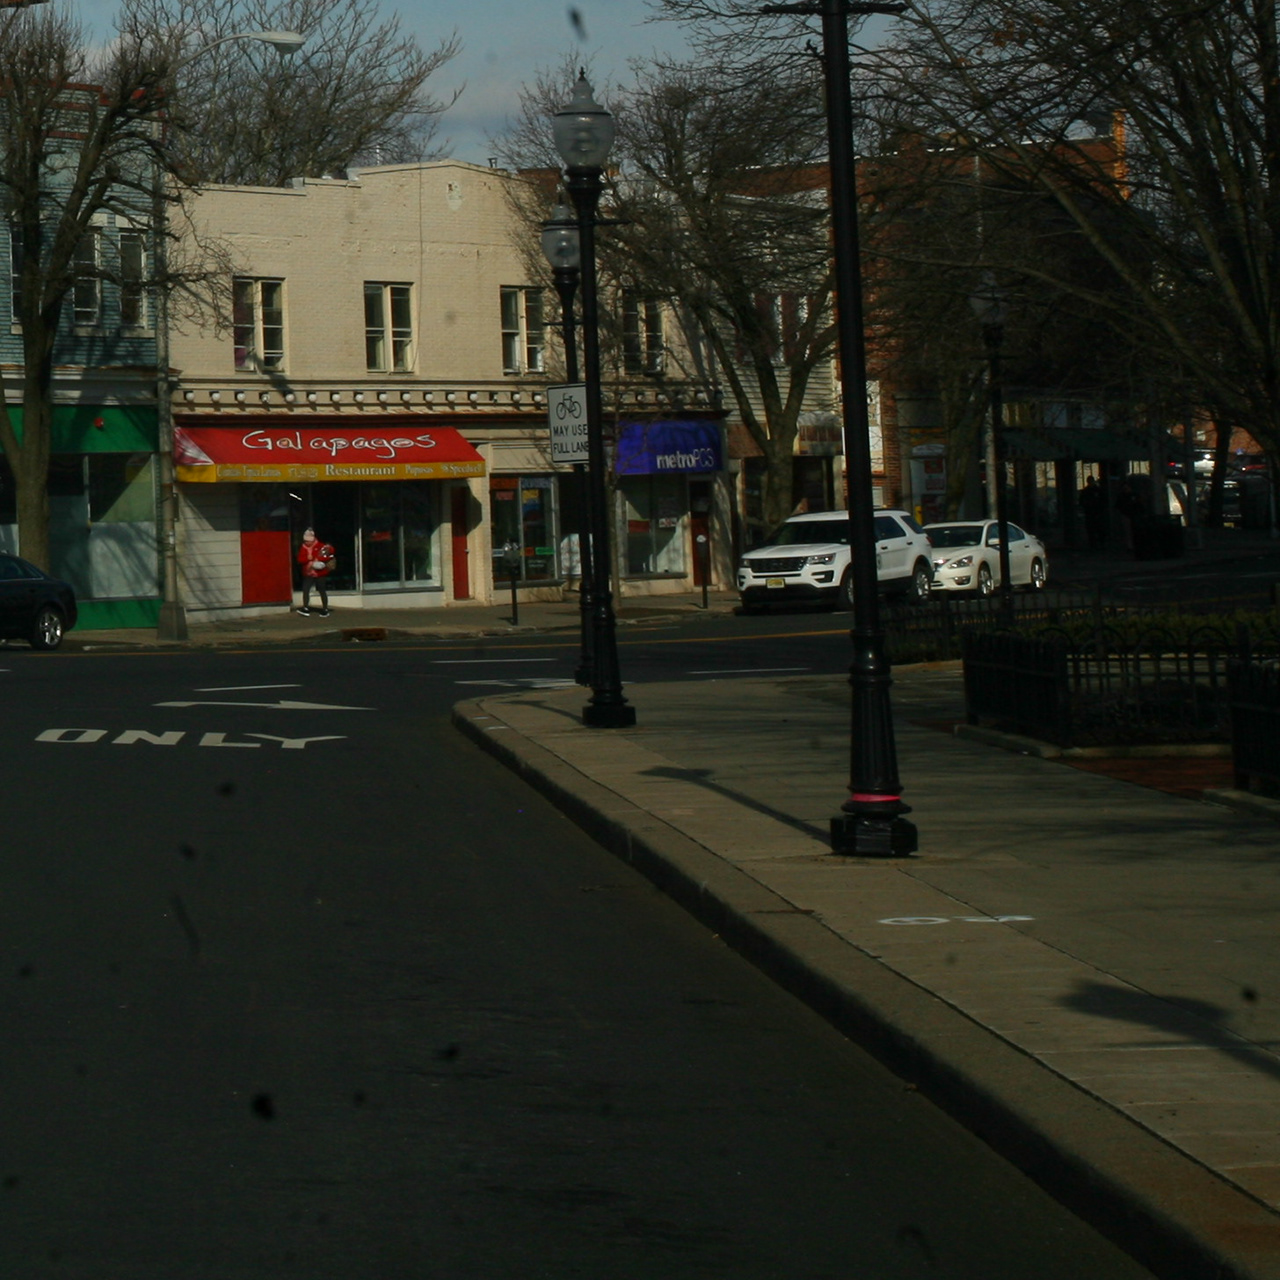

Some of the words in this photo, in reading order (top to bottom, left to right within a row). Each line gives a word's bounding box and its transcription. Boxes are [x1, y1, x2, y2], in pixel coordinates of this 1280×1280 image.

[553, 425, 569, 437] MAY
[572, 424, 588, 436] USE
[242, 430, 436, 459] Galapagos
[553, 442, 570, 454] FULL
[657, 448, 715, 469] metroPCS
[324, 464, 396, 476] Restaurant
[34, 728, 348, 749] ONLY
